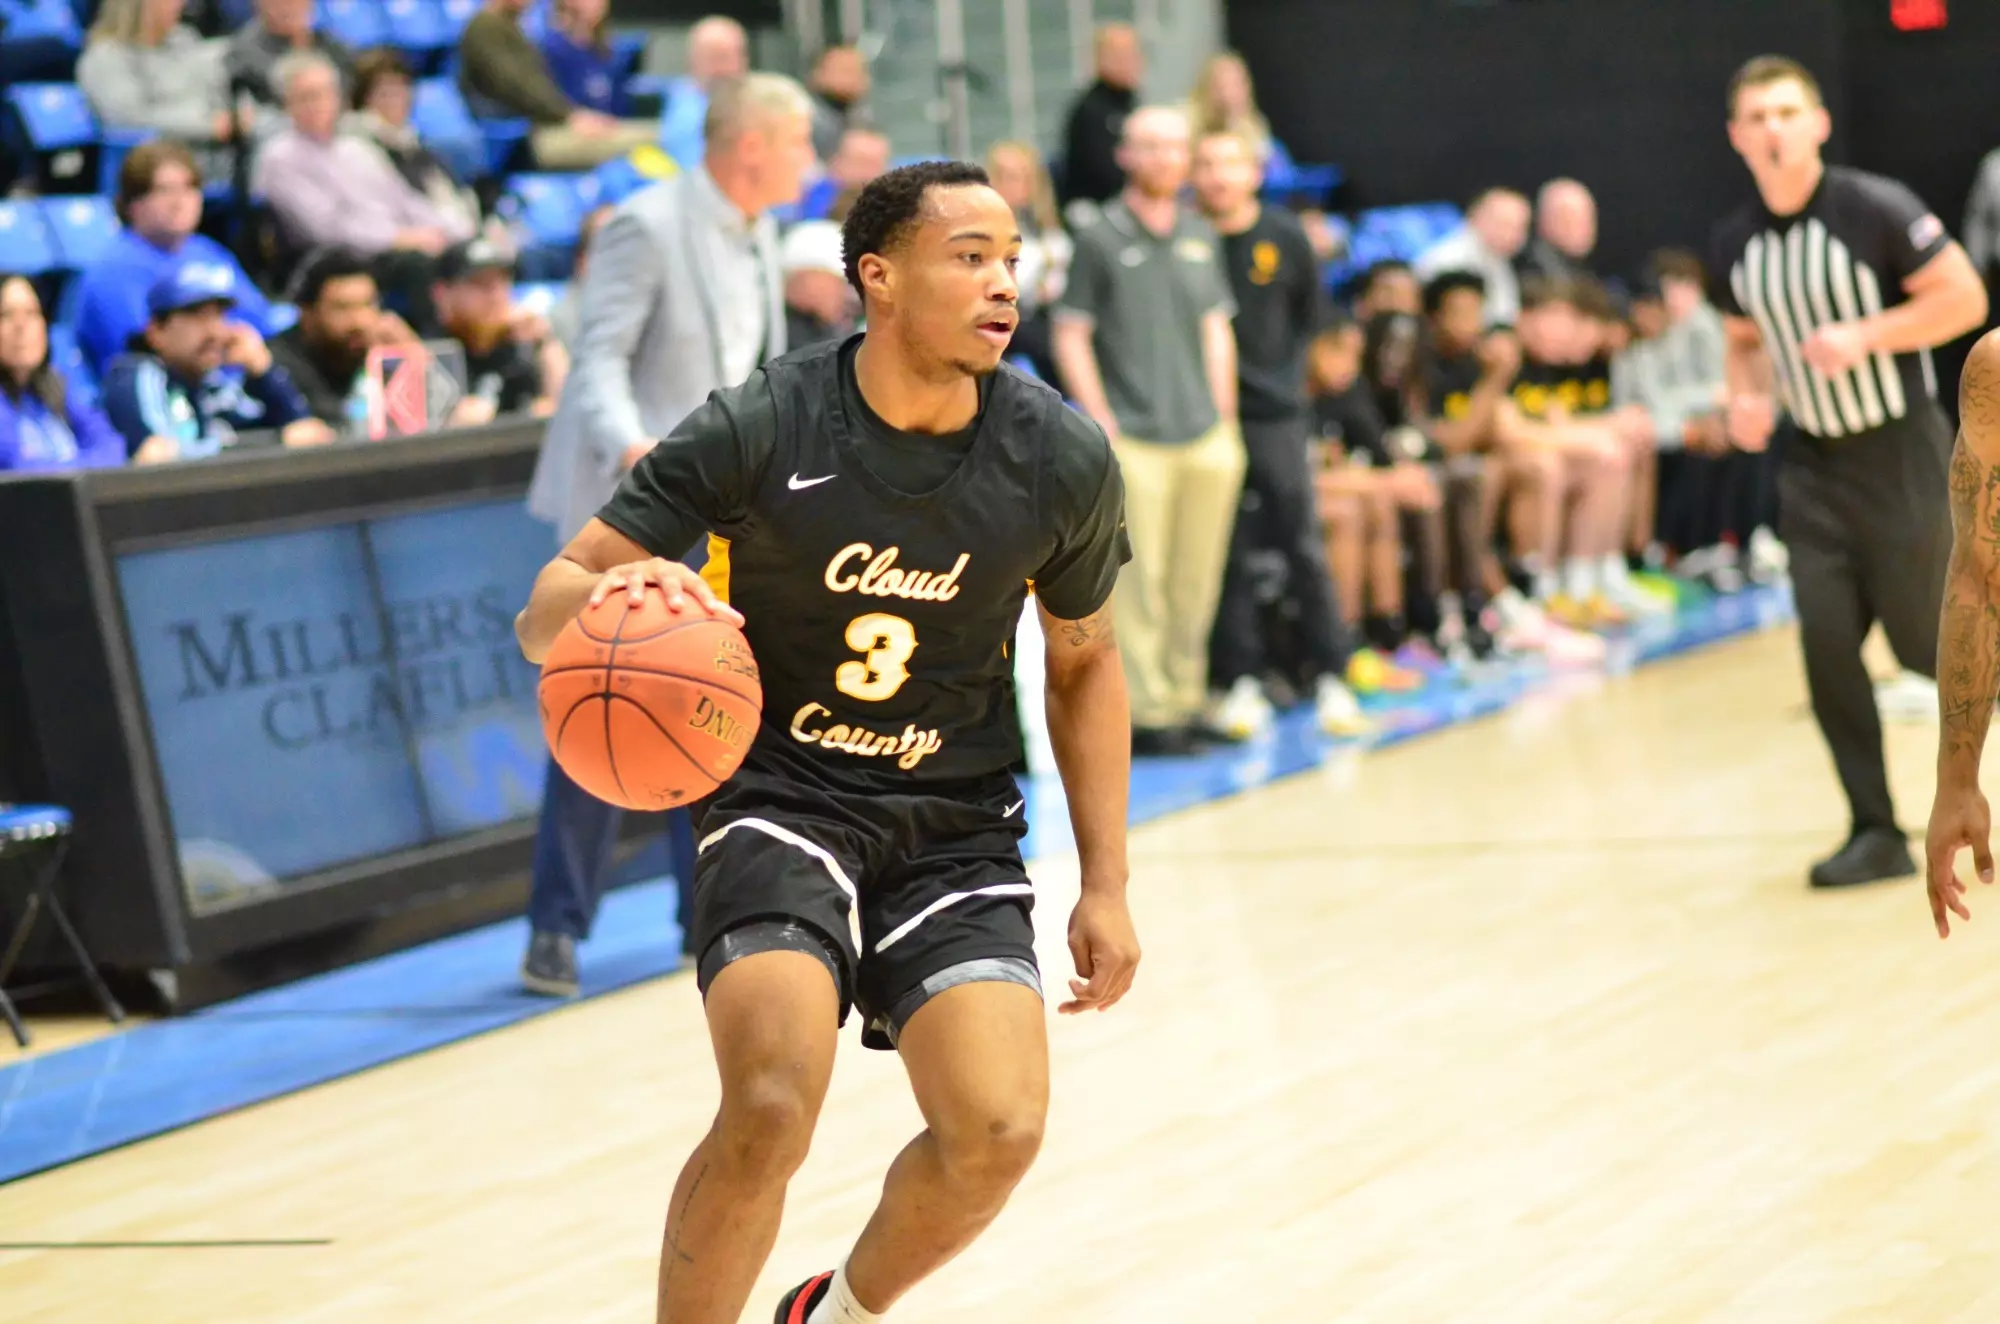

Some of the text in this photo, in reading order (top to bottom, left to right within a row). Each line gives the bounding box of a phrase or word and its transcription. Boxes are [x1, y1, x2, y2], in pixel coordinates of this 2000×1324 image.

[824, 542, 971, 602] Cloud
[835, 612, 920, 702] 3
[789, 701, 943, 770] County
